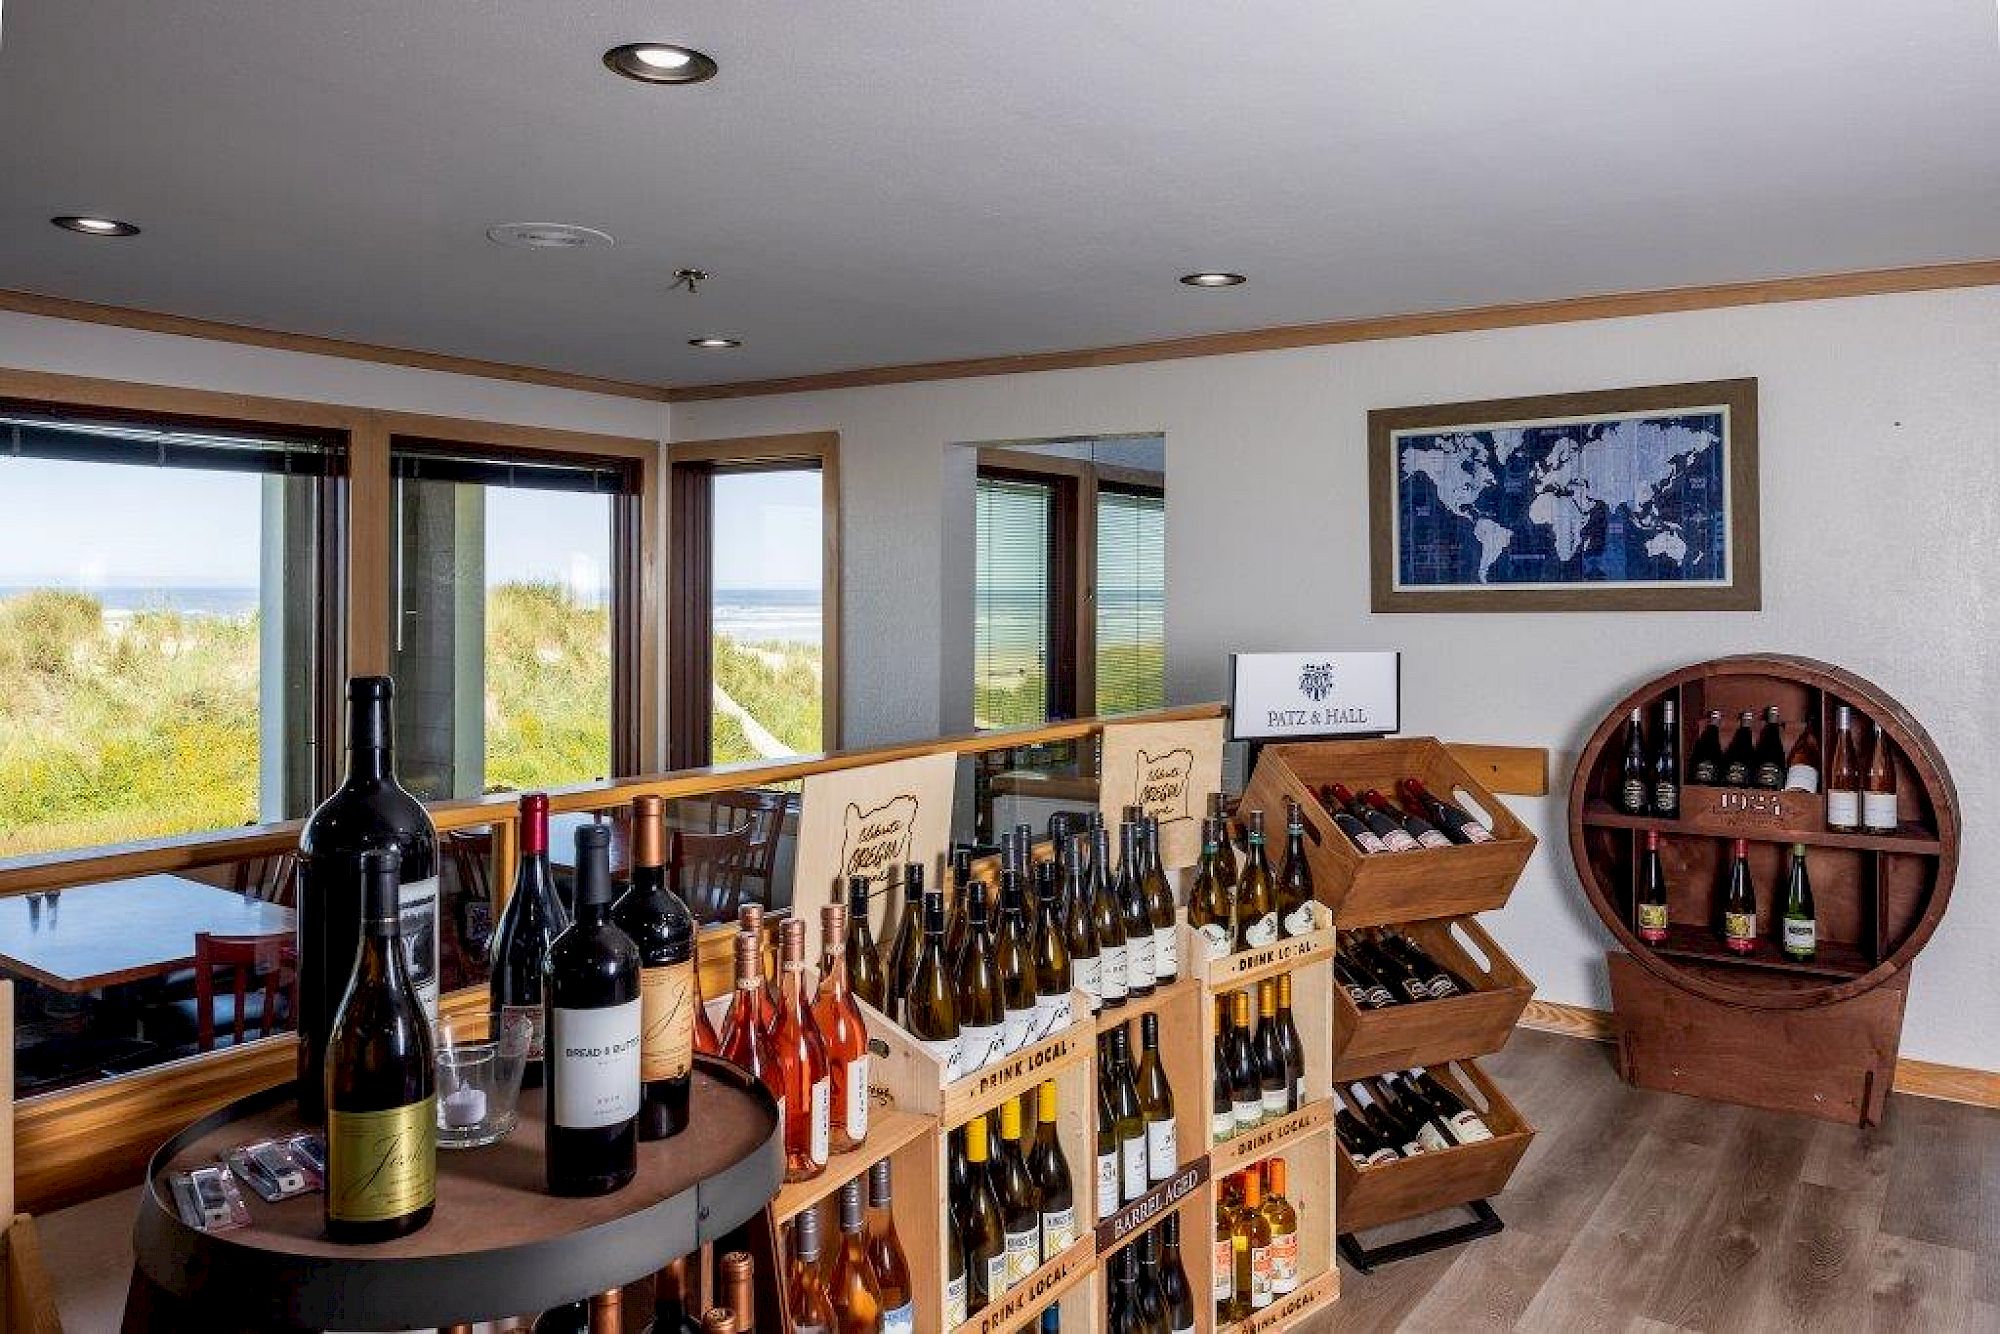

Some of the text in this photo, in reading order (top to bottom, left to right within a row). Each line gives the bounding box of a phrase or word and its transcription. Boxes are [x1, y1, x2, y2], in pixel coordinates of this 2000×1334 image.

[1267, 708, 1368, 727] PATZ & HALL
[1239, 941, 1312, 971] DRINK LOCAL
[565, 1047, 602, 1059] BREAD
[980, 1040, 1068, 1094] DRINK LOCAL
[1237, 1115, 1311, 1156] DRINK LOCAL
[1114, 1168, 1199, 1240] BARREL AGED
[982, 1262, 1068, 1334] DRINK LOCAL
